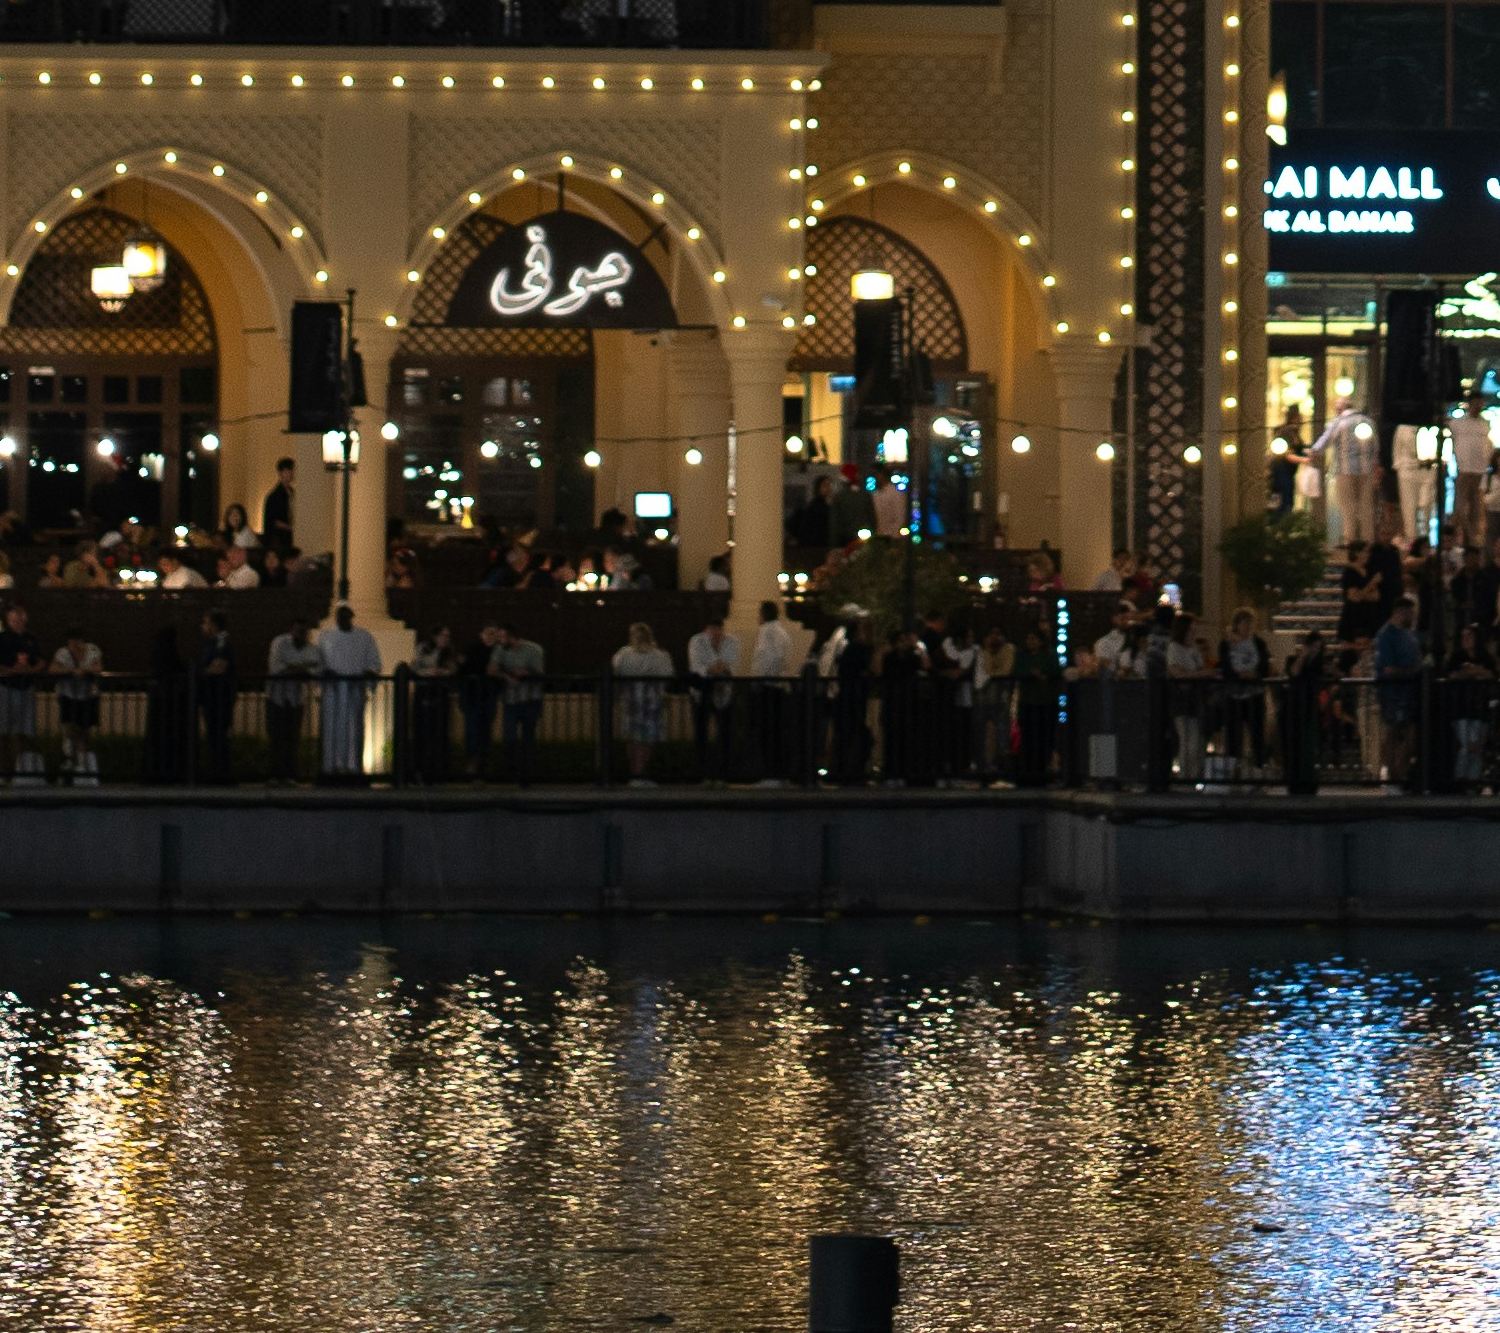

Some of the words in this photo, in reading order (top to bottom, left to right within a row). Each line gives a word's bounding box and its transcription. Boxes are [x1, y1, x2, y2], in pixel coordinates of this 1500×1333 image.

[1263, 165, 1318, 199] AI
[1329, 166, 1443, 200] MALL
[1291, 210, 1327, 233] AL
[1328, 210, 1415, 234] BAHAR
